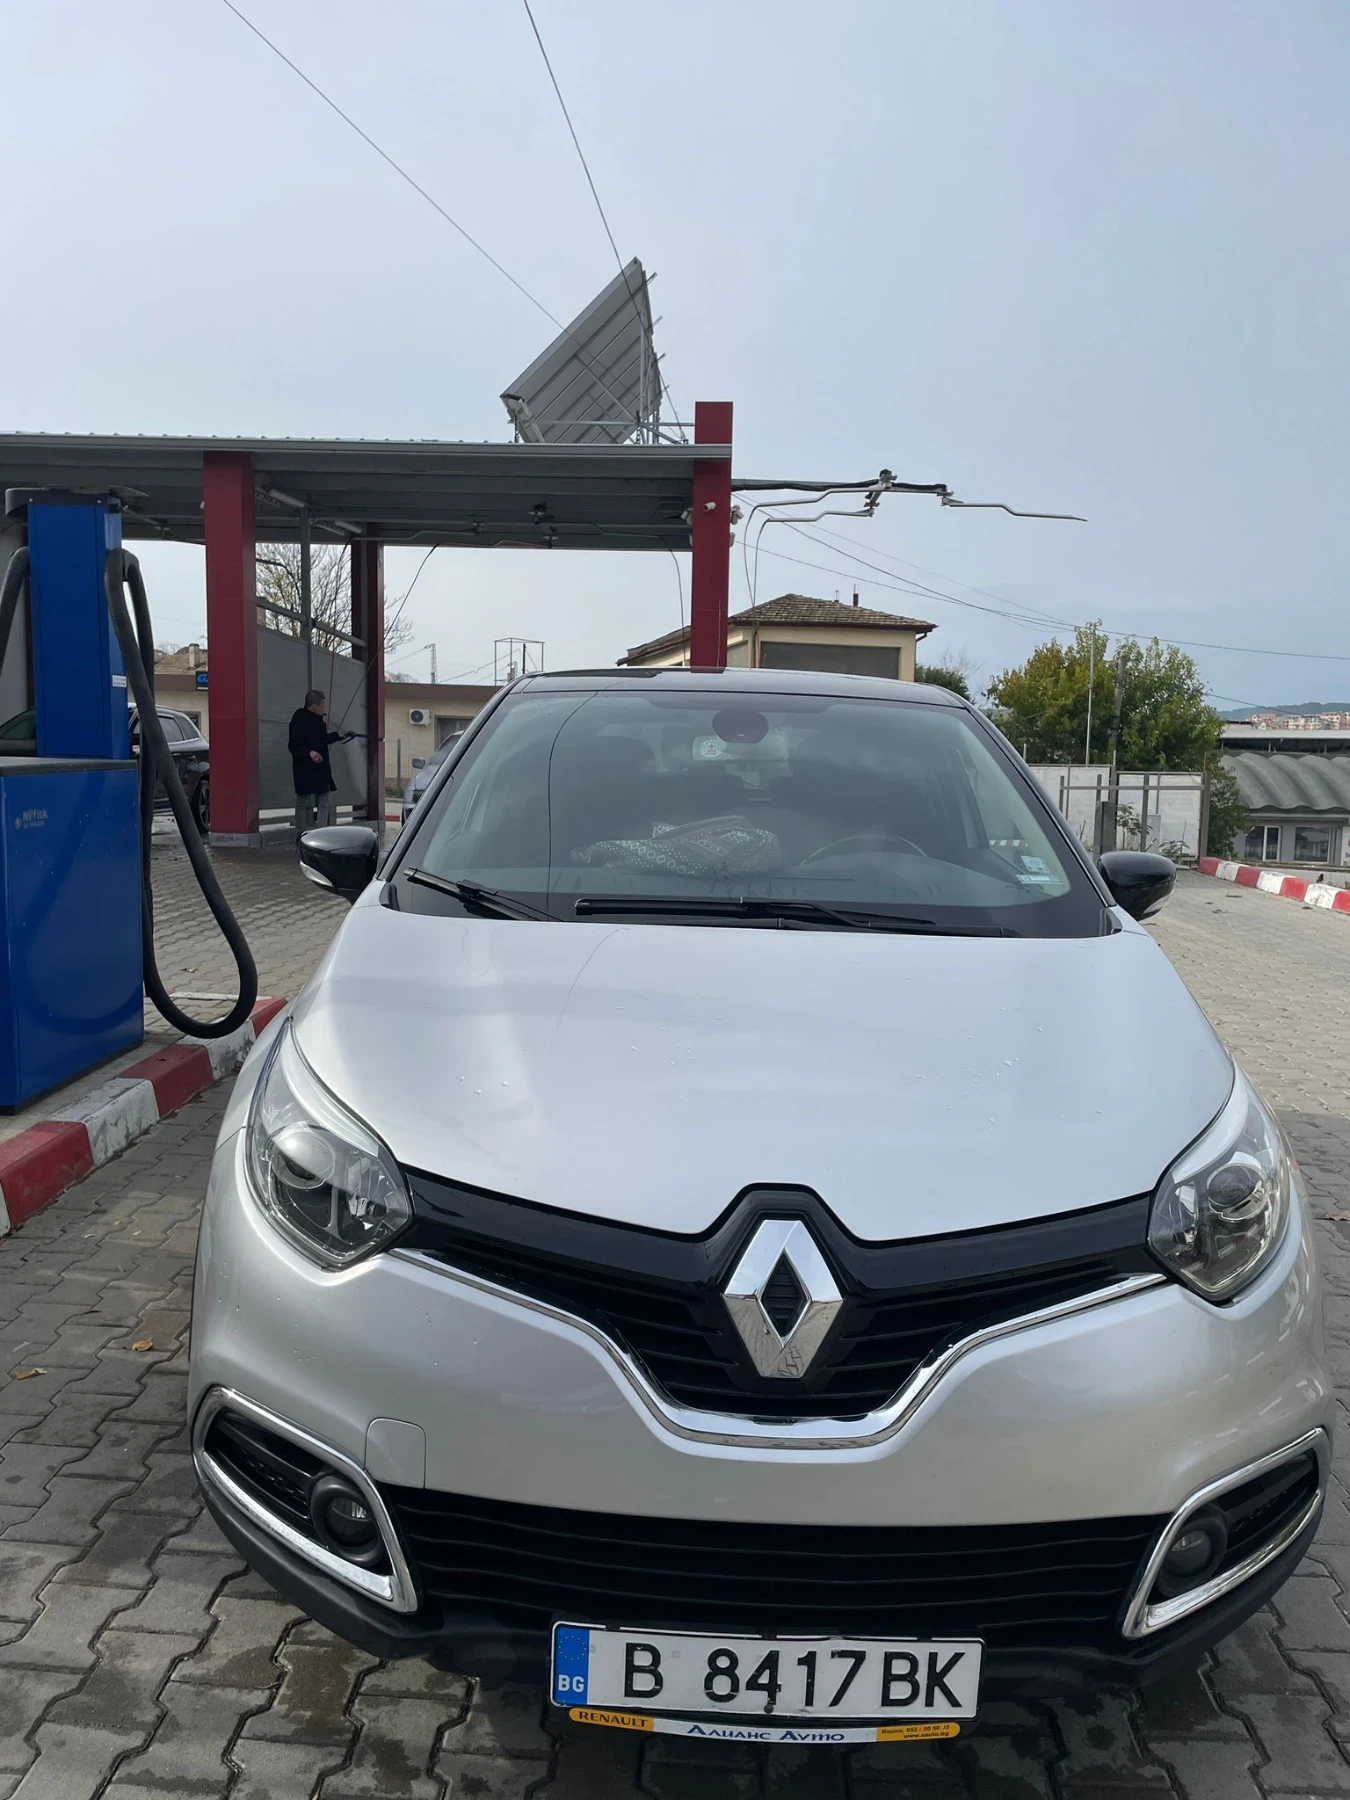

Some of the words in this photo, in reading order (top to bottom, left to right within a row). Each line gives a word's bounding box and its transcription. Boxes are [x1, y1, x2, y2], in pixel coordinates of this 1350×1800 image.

[558, 1674, 585, 1692] BG
[624, 1642, 664, 1699] B
[704, 1647, 866, 1708] 8417
[880, 1651, 965, 1708] BK
[579, 1710, 650, 1728] RENAULT
